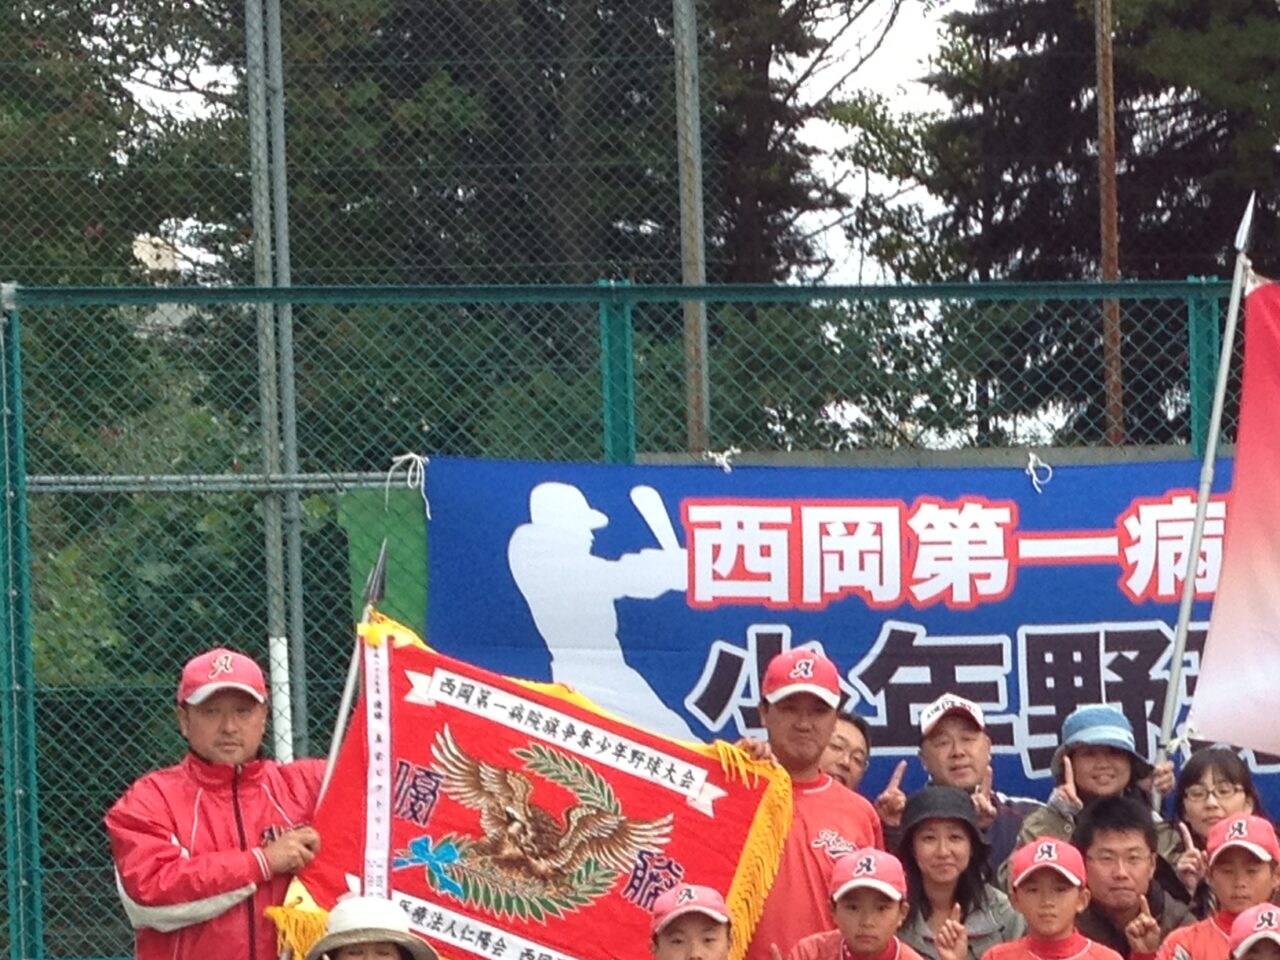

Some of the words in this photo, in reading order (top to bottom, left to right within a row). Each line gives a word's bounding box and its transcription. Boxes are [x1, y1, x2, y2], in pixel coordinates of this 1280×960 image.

[683, 494, 1230, 606] 西岡第一病
